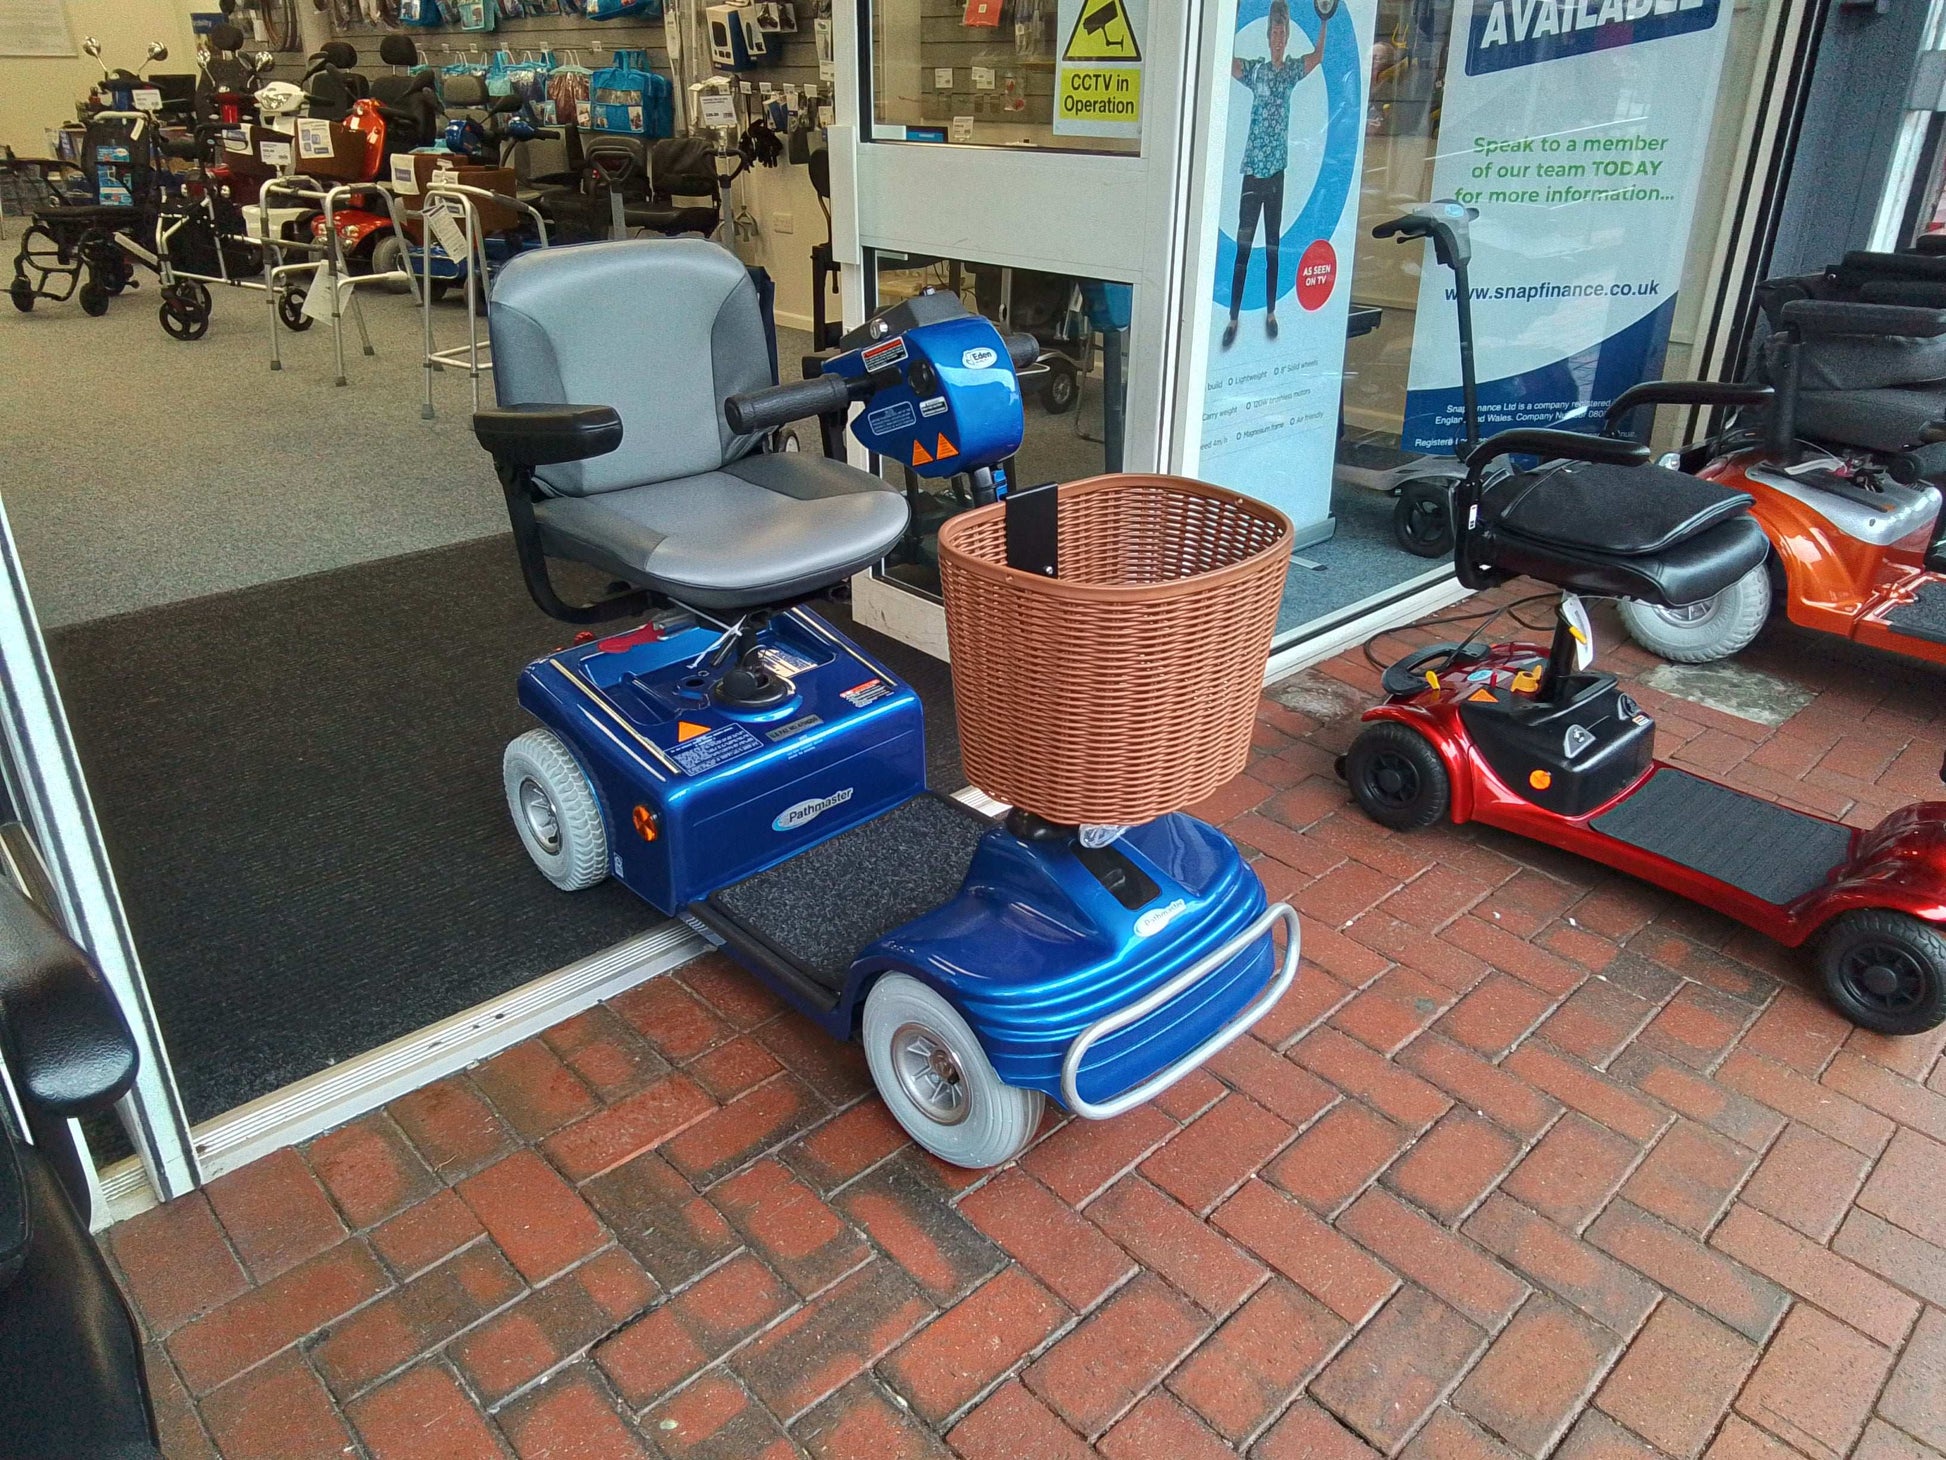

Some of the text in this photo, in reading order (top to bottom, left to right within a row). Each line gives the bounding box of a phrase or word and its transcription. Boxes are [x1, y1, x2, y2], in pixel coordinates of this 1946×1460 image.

[1071, 73, 1129, 91] CCTV in
[1064, 95, 1134, 116] Operation
[1473, 135, 1668, 157] Speak to a member
[1472, 160, 1663, 178] of our team TODAY
[1455, 185, 1674, 204] for more information...
[1303, 264, 1331, 276] AS SEEN
[1306, 276, 1327, 286] ON TV
[1445, 280, 1660, 302] ww.snapfinance.co.uk
[972, 351, 992, 361] Eden
[1504, 402, 1516, 411] Ltd
[1518, 402, 1526, 410] is
[1534, 401, 1569, 411] company
[1516, 411, 1556, 422] Company
[790, 789, 851, 823] Pathmaster
